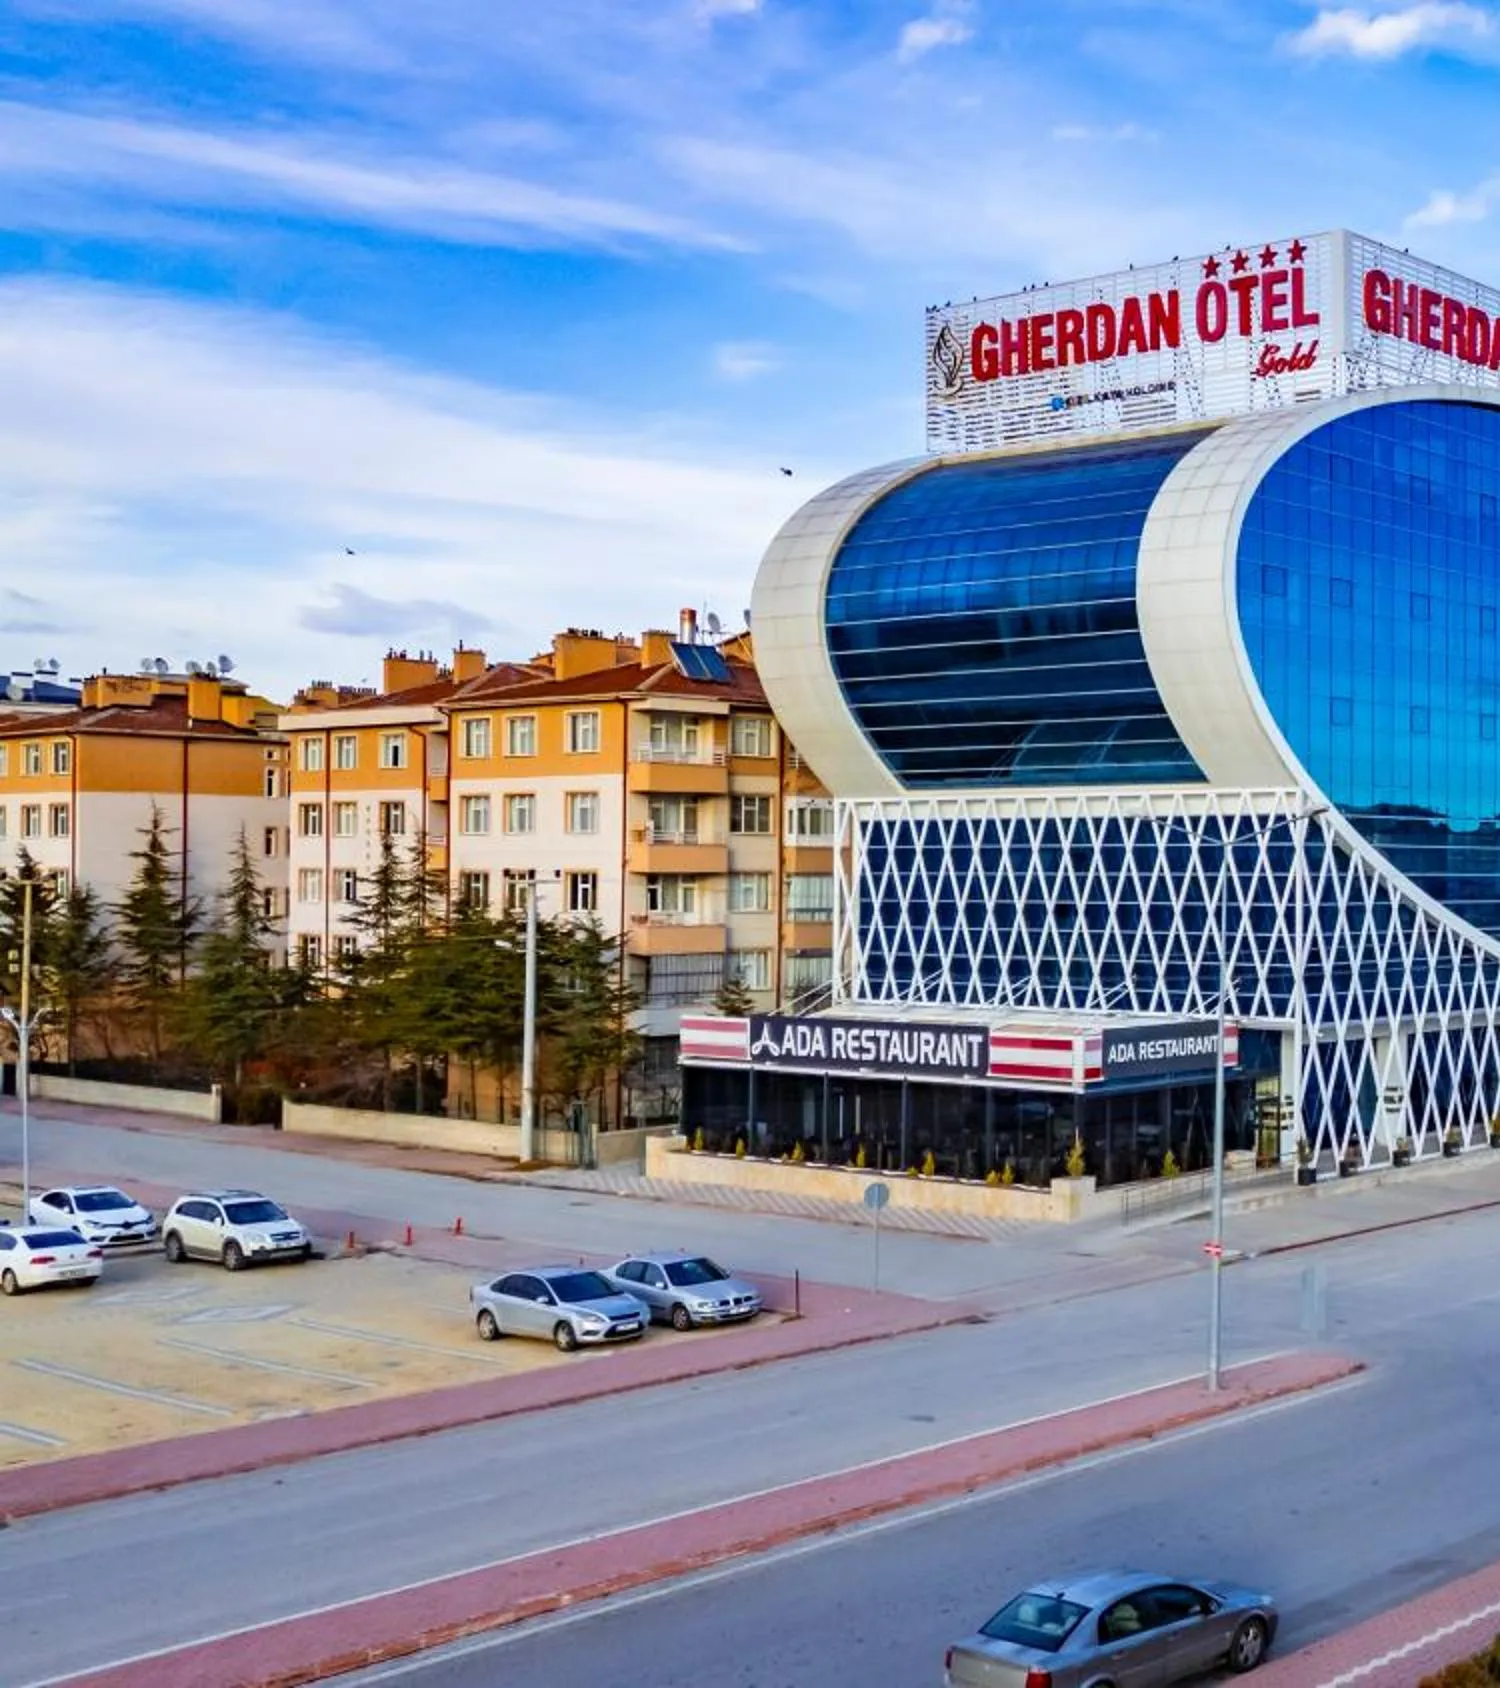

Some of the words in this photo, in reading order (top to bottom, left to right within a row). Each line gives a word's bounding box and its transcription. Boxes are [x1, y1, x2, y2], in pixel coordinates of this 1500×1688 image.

[970, 289, 1181, 383] GHERDAN
[1256, 339, 1319, 377] Gold
[780, 1024, 828, 1059] ADA
[831, 1027, 984, 1069] RESTAURANT
[1107, 1043, 1136, 1064] ADA
[1138, 1034, 1219, 1062] RESTAURANT
